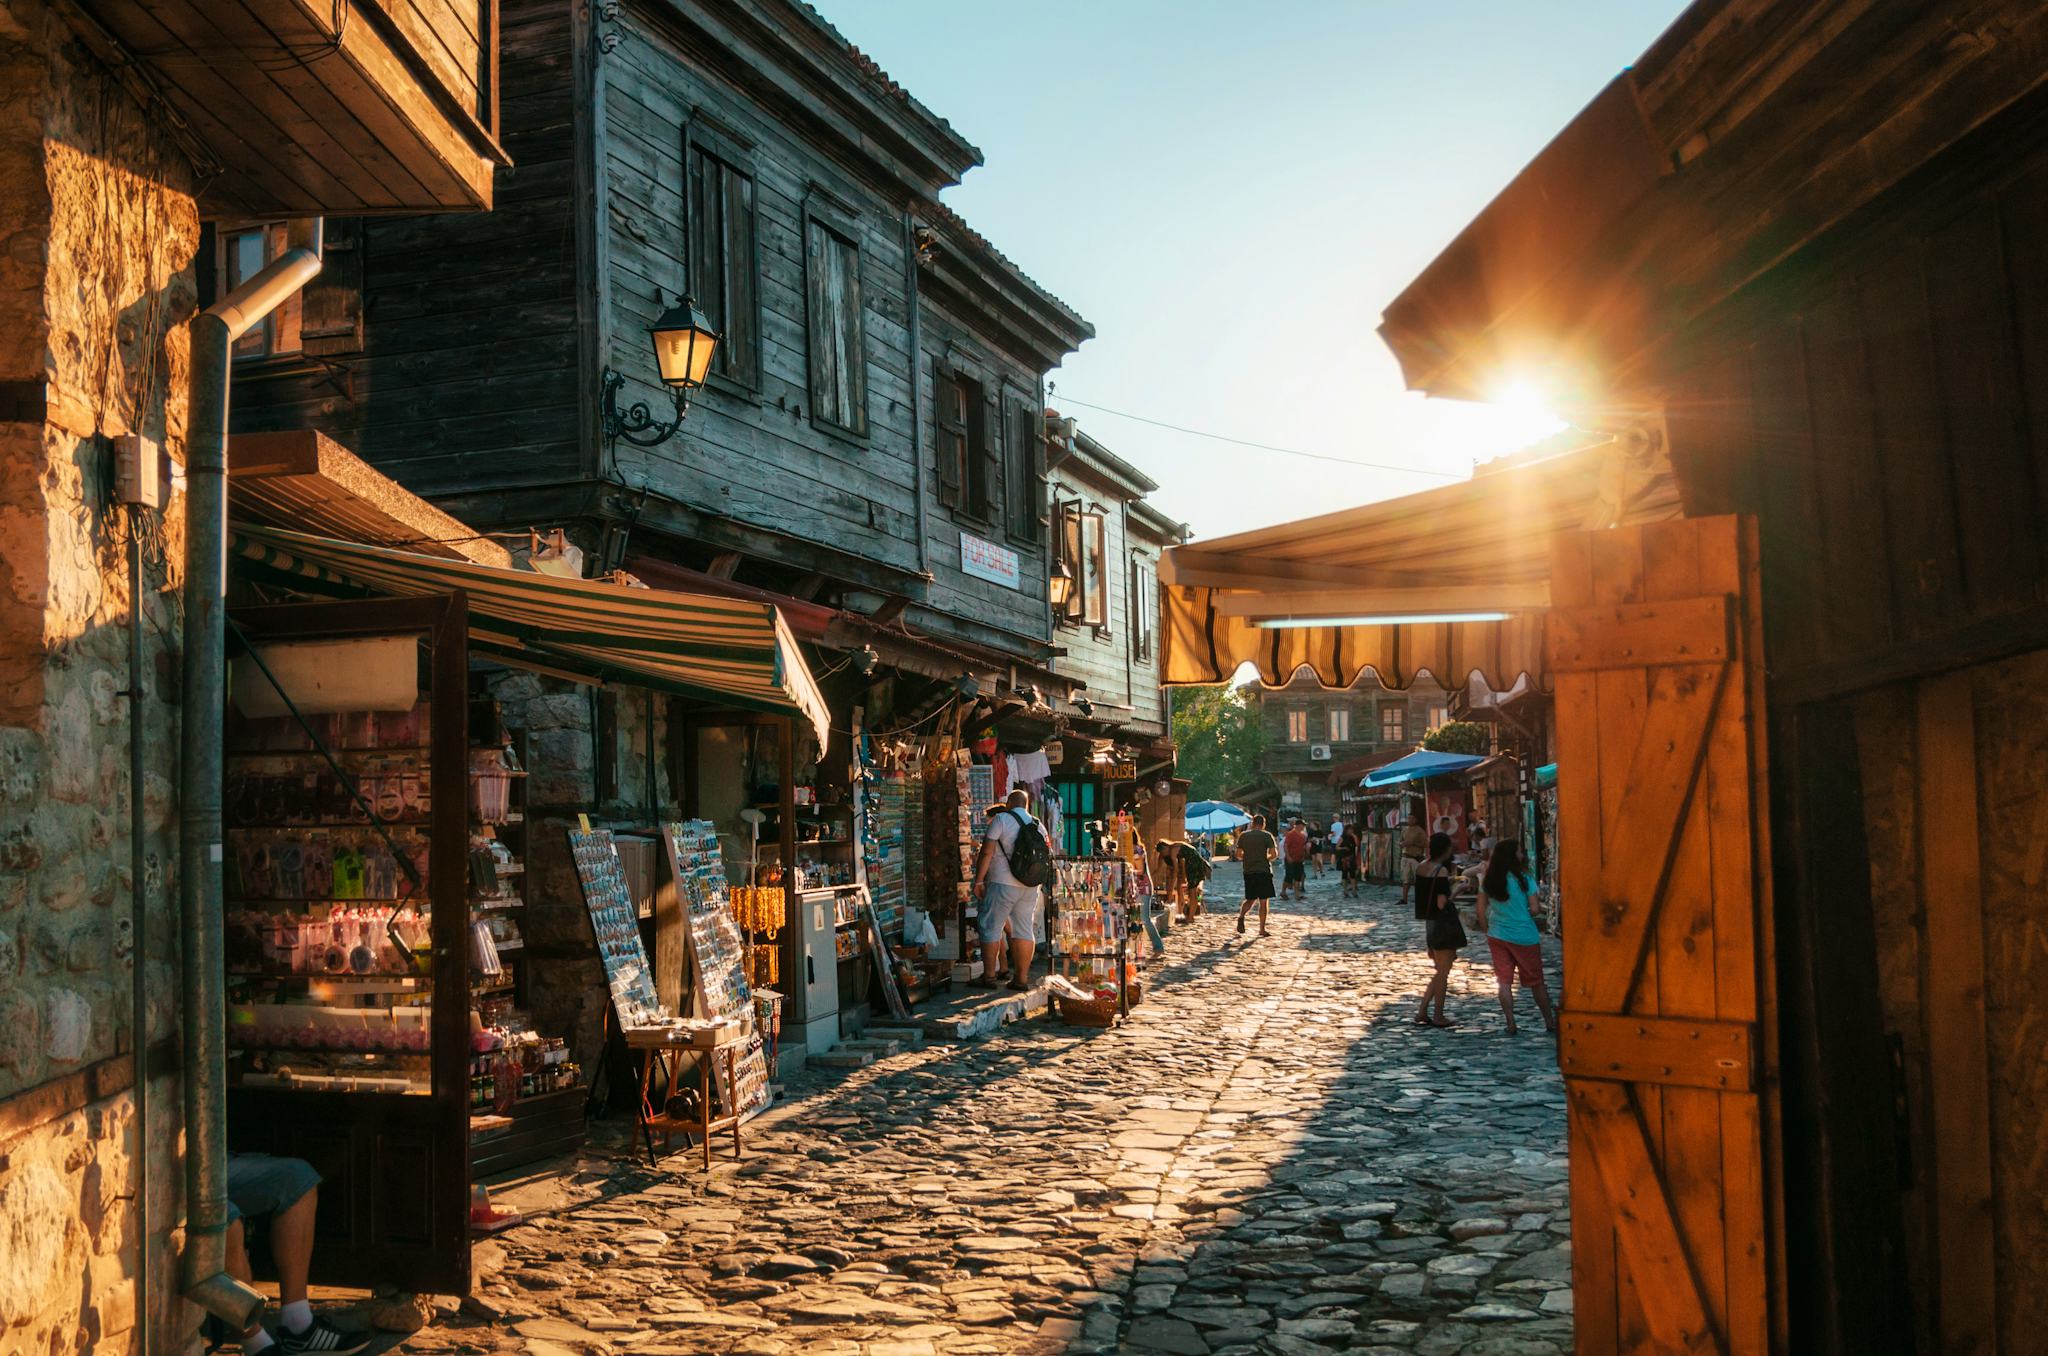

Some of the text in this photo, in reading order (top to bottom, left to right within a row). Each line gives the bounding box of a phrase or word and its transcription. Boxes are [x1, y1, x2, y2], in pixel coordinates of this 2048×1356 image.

[964, 535, 1013, 576] FOR SALE
[1103, 763, 1134, 779] HOUSE
